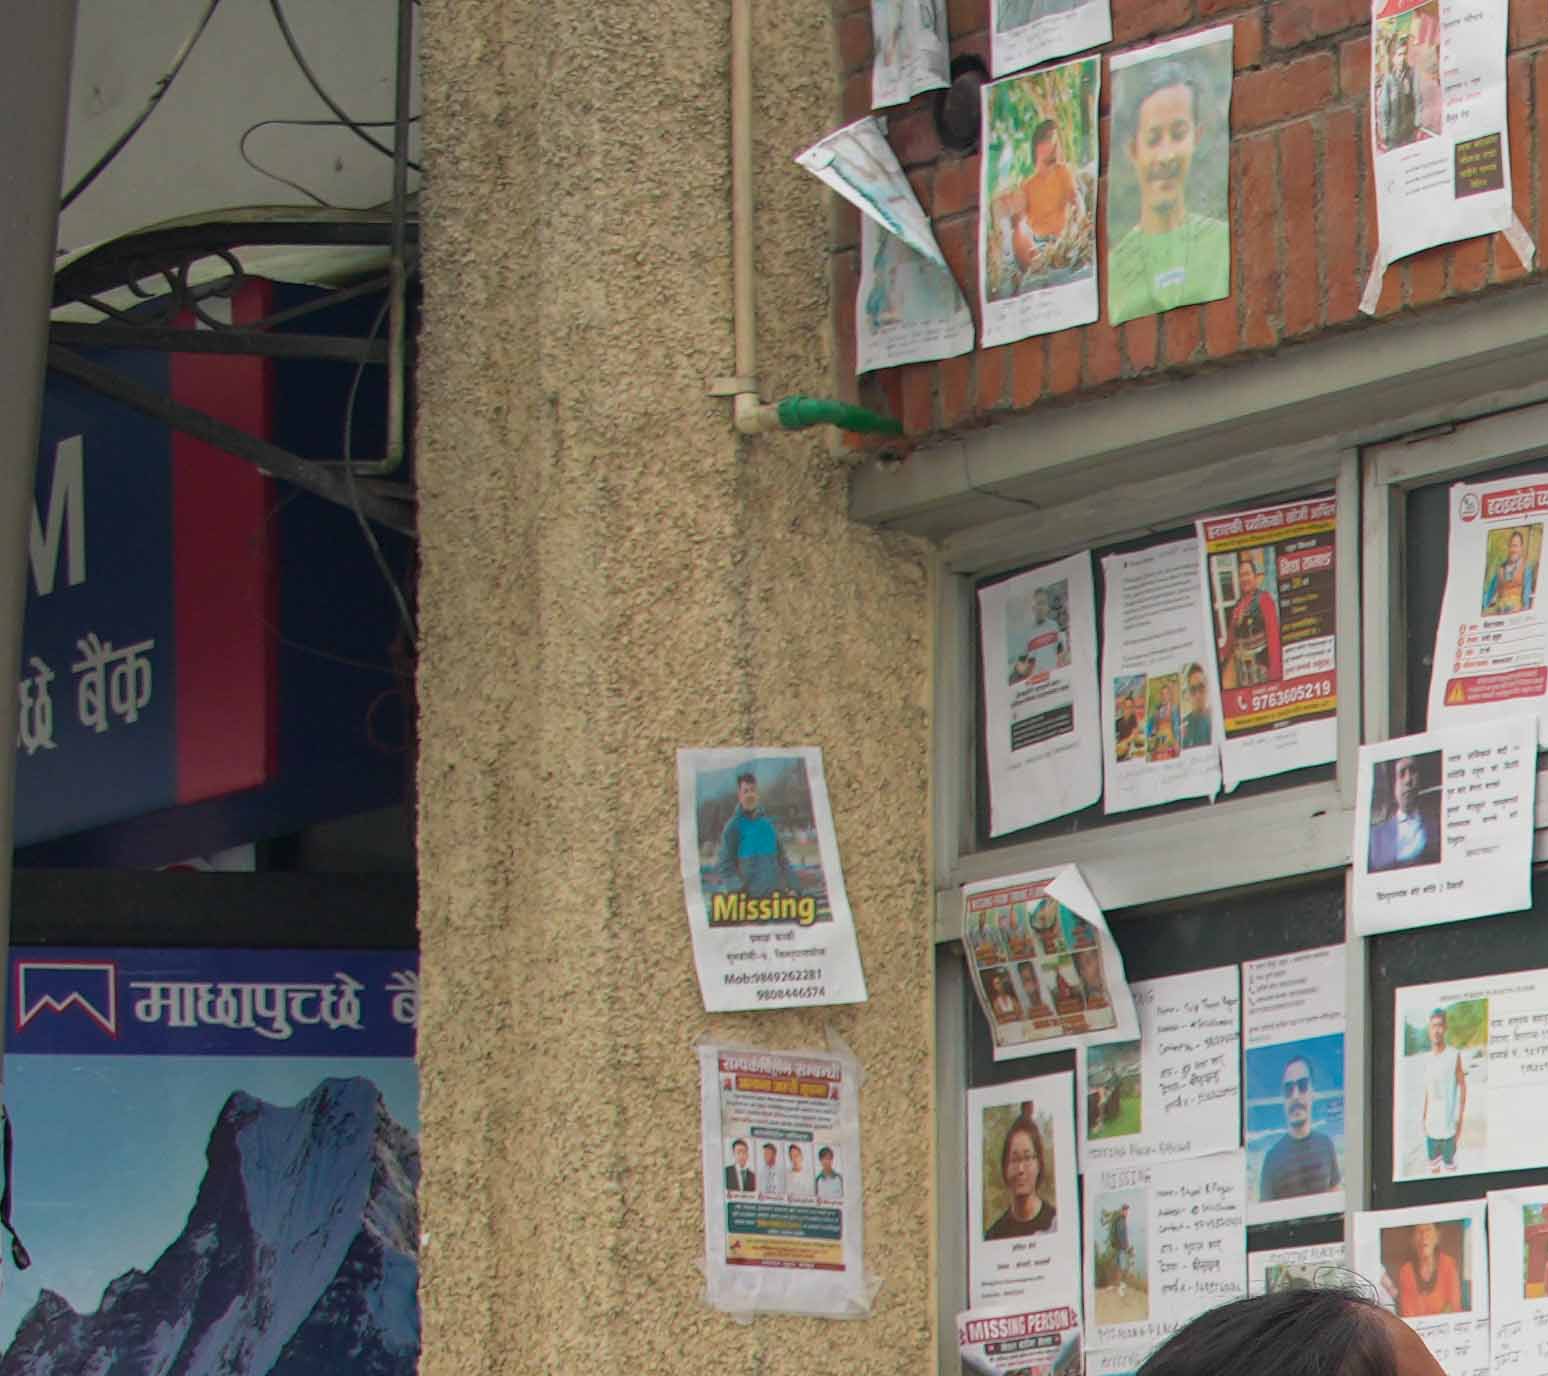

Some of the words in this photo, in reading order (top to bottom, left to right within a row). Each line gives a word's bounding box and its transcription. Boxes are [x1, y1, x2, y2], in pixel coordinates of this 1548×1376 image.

[713, 893, 816, 925] Missing
[968, 1316, 1026, 1344] MISSING
[1028, 1308, 1071, 1336] PERSON
